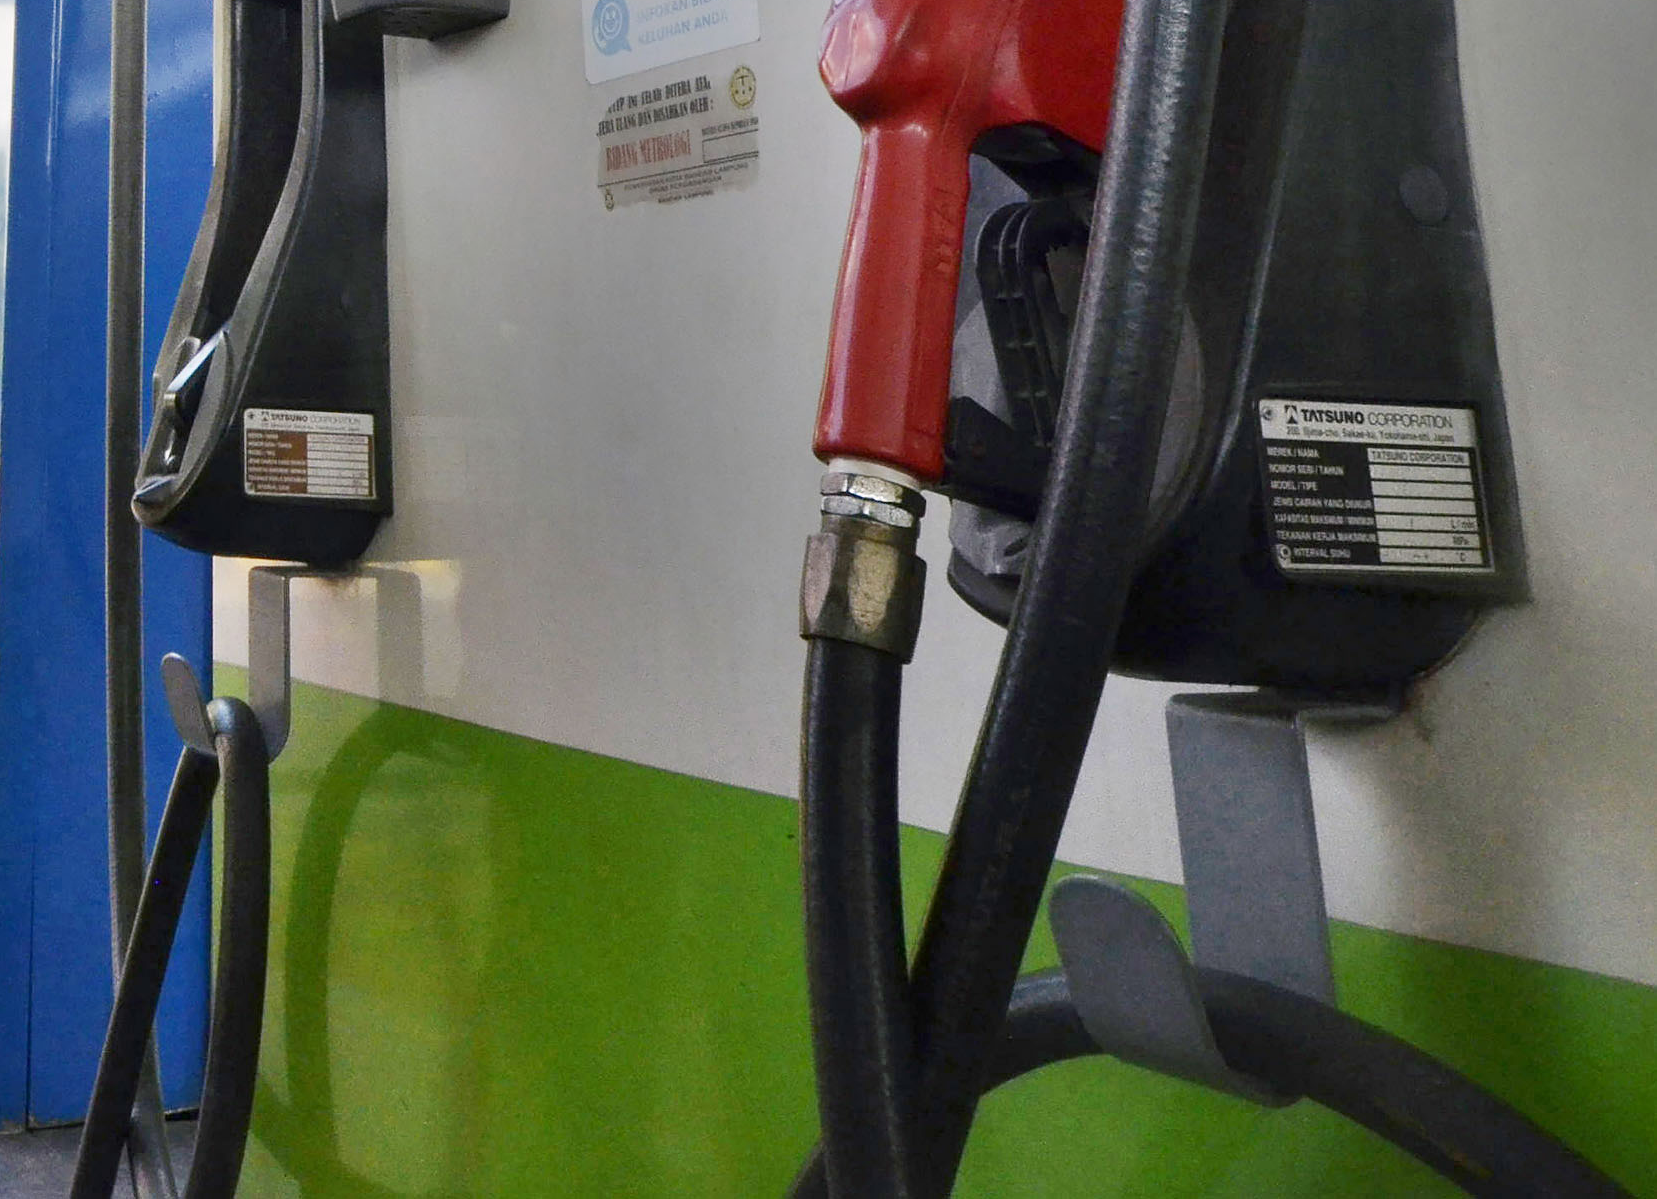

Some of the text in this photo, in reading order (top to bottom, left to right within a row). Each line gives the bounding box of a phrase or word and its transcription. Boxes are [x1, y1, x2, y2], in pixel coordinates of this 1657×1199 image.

[638, 9, 729, 45] KELUHAN ANDA
[1300, 408, 1453, 429] TATSUNO CORPORATION
